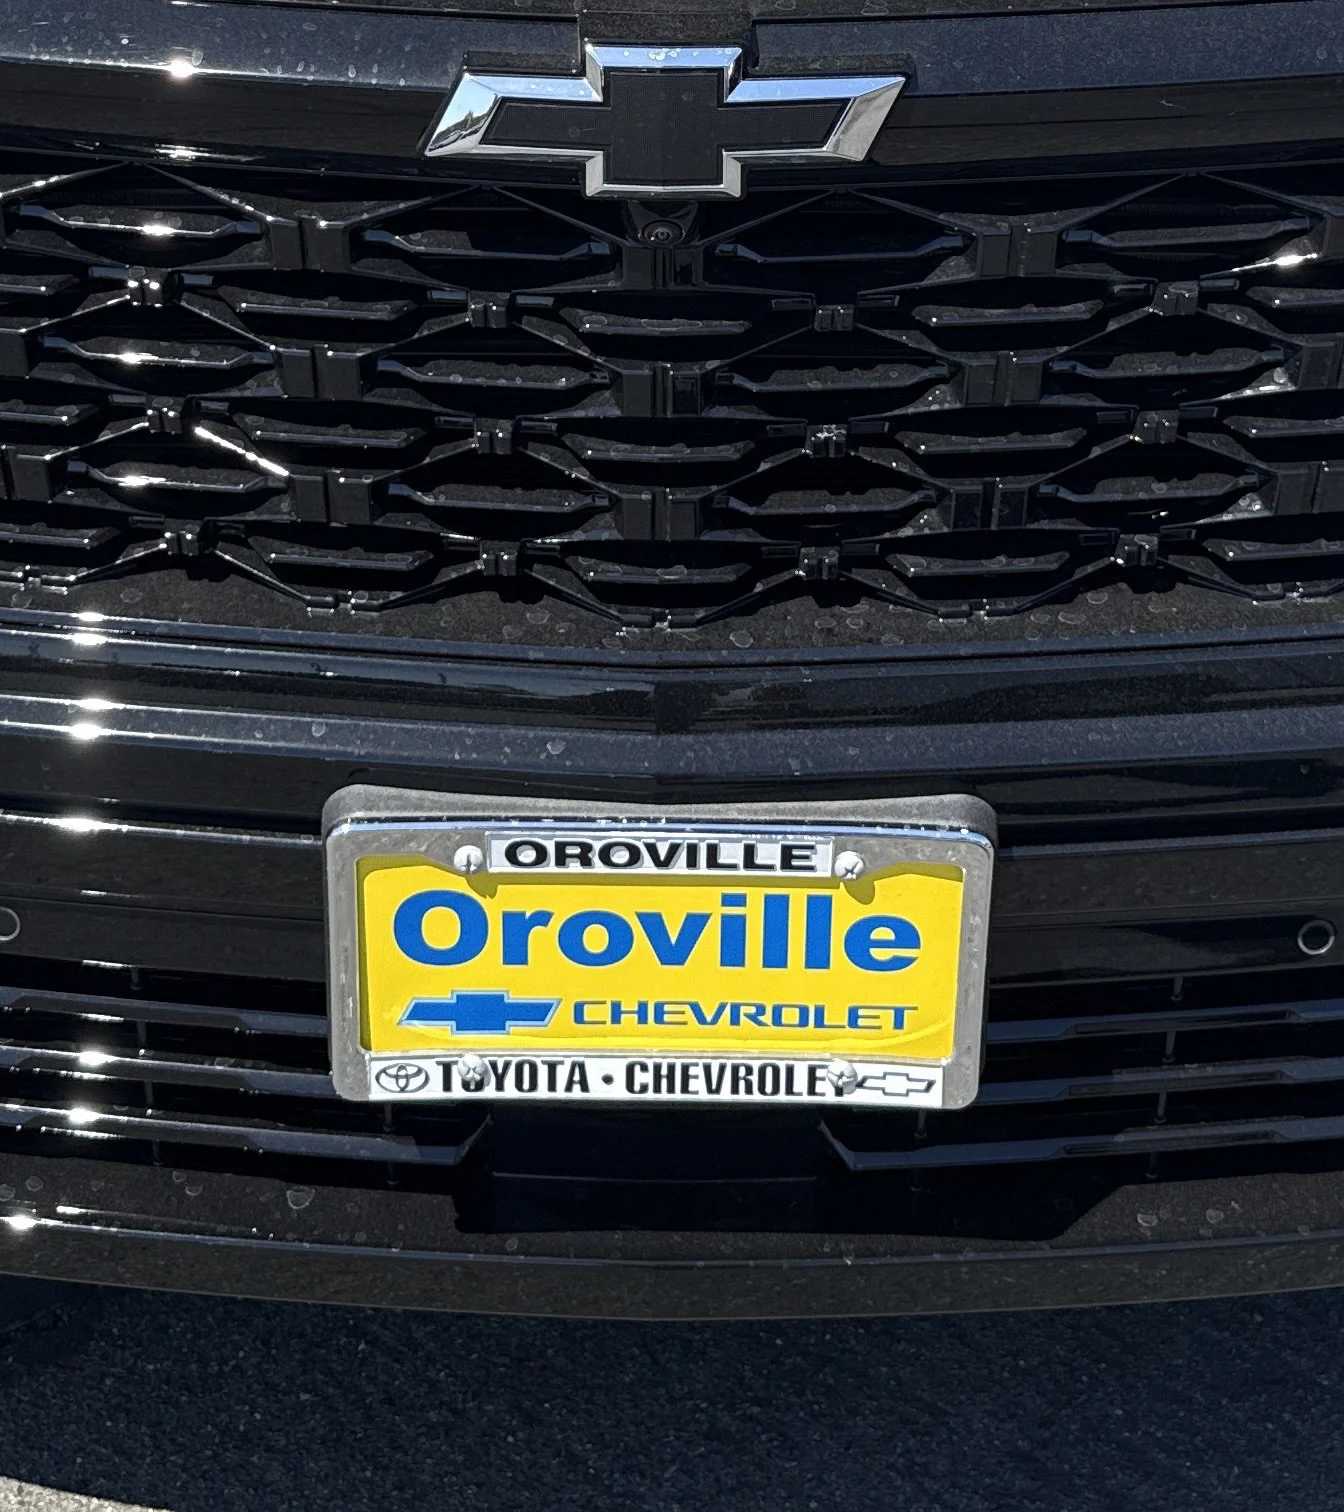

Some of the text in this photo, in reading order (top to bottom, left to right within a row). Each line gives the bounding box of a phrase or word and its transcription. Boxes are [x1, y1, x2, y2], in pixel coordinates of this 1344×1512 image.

[504, 839, 817, 872] OROVILLE
[392, 889, 922, 973] Oroville
[573, 998, 920, 1033] CHEVROLET
[624, 1059, 846, 1097] CHEVROLE
